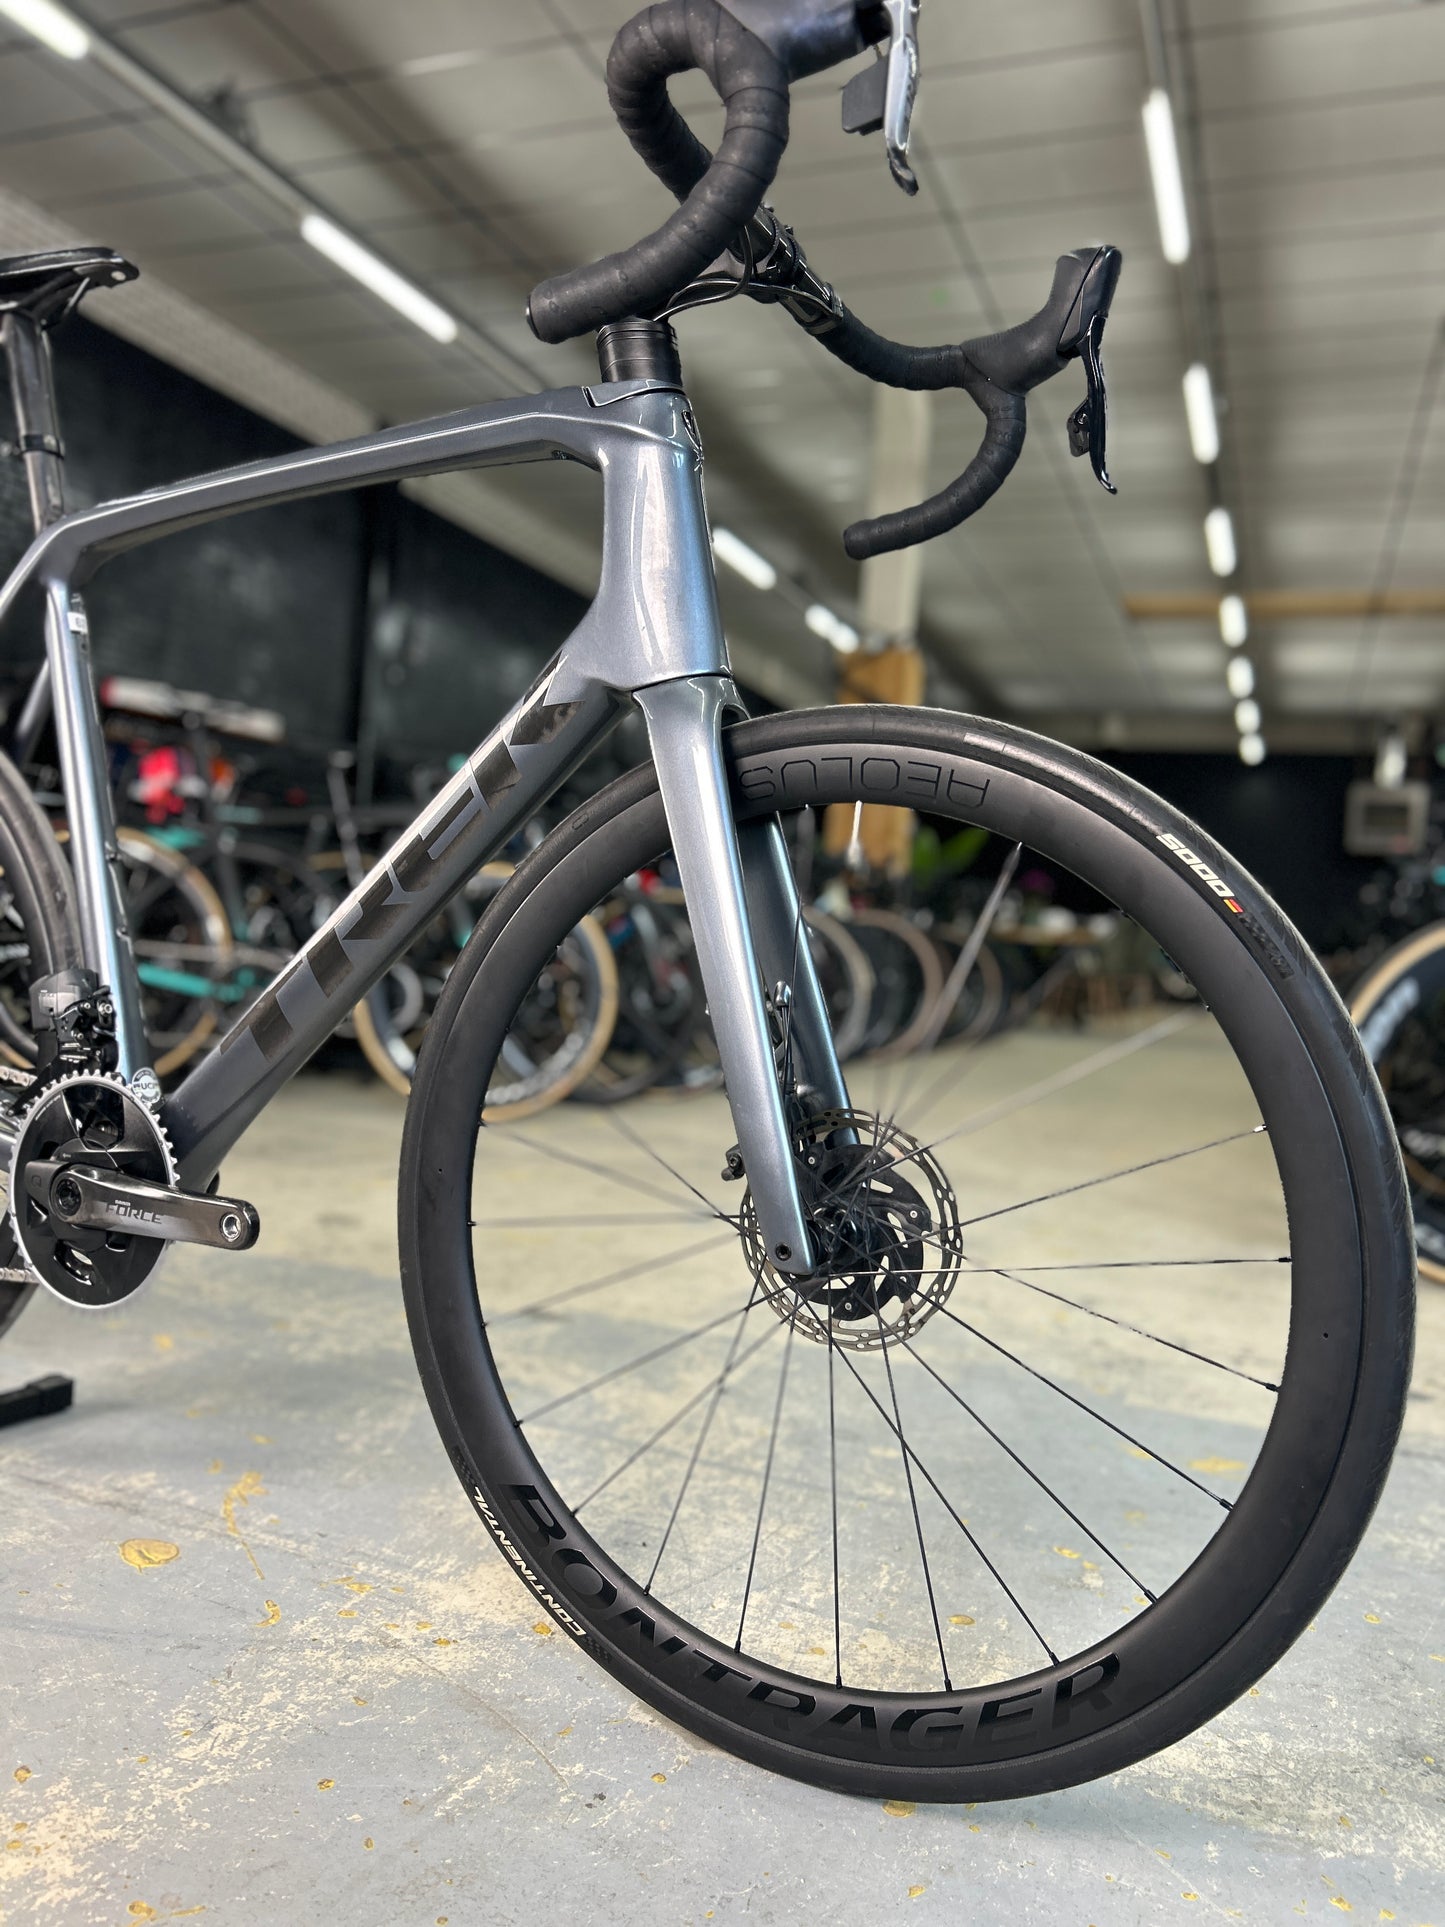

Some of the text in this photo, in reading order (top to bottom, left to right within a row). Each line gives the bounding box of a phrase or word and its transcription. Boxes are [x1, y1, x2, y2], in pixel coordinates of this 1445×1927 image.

[739, 756, 991, 808] AEOLUS
[219, 650, 585, 1062] TREK
[1156, 833, 1235, 897] 5000
[106, 1202, 162, 1224] FORCE
[474, 1486, 587, 1636] CONTINENTAL
[503, 1483, 1120, 1750] BONTRAGER
